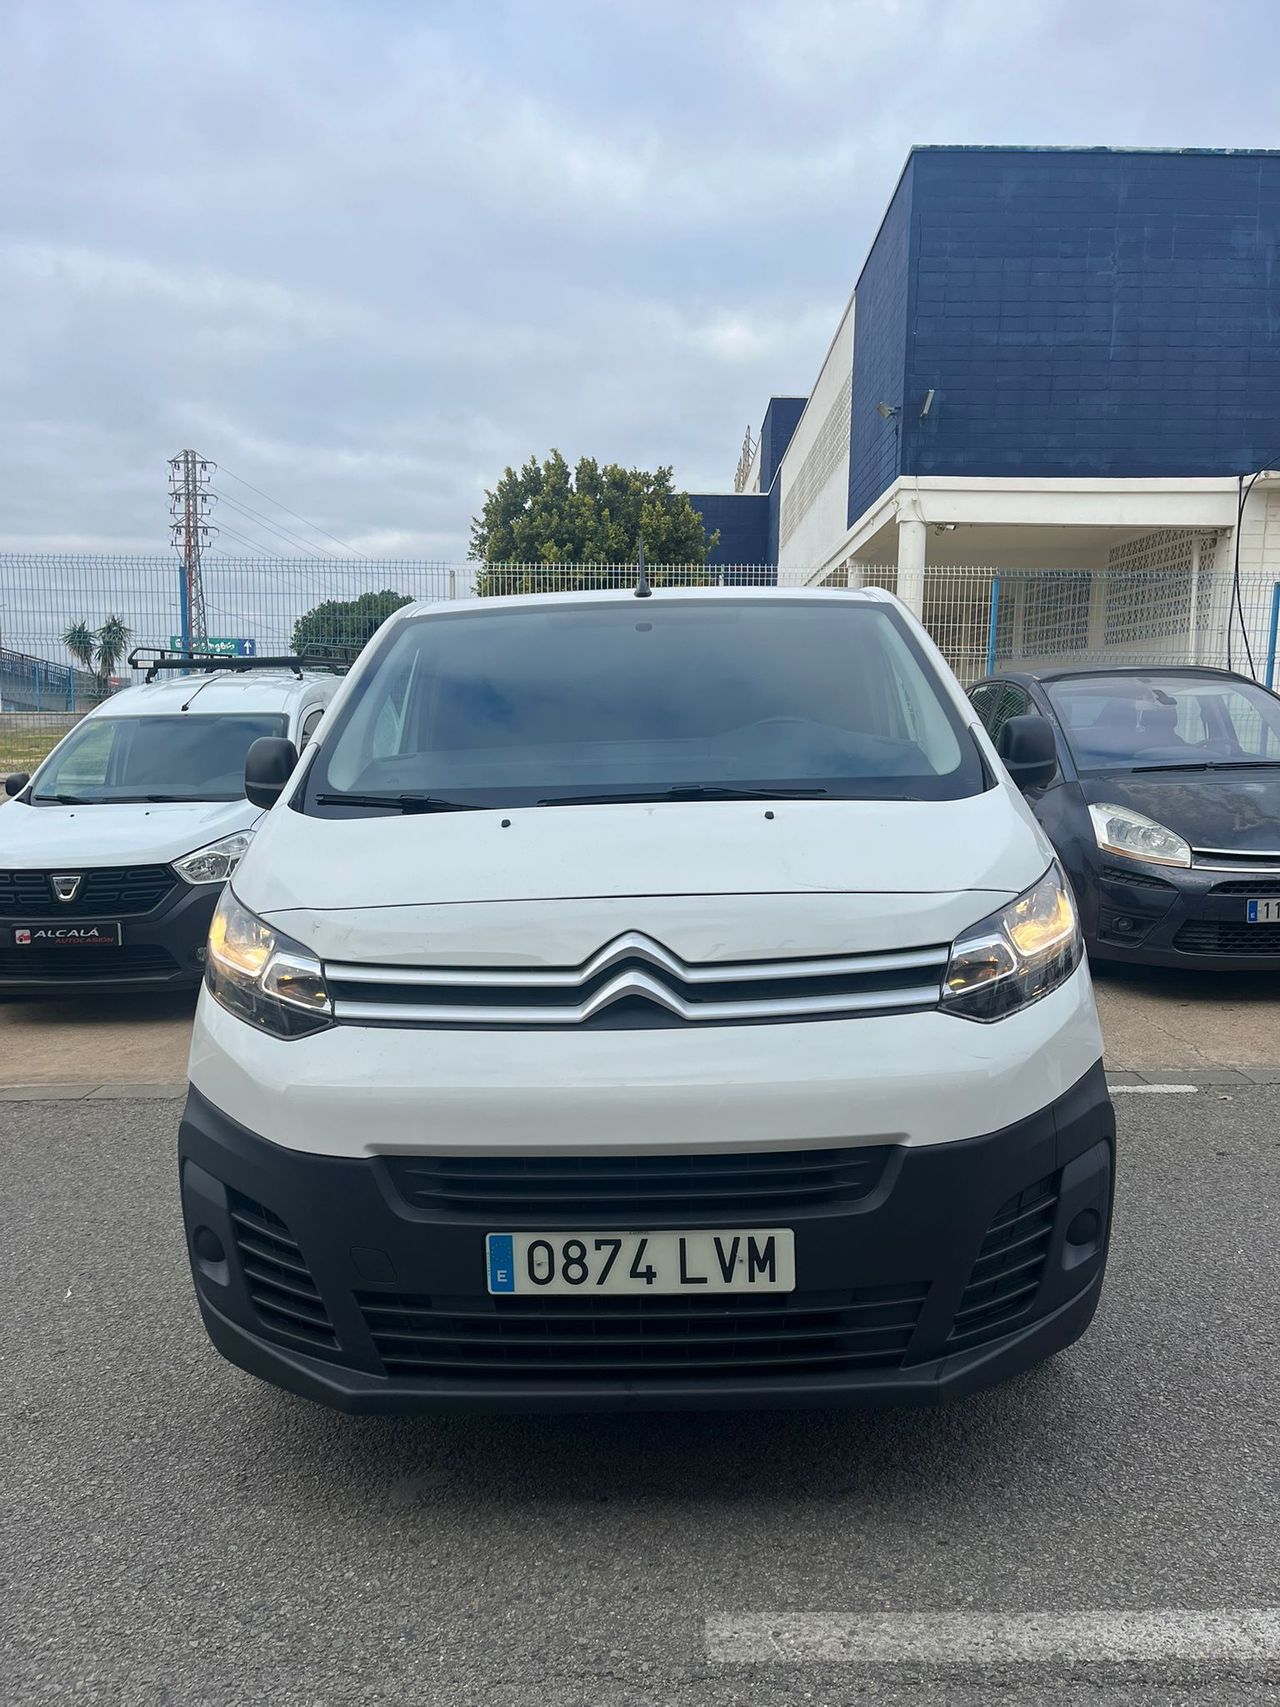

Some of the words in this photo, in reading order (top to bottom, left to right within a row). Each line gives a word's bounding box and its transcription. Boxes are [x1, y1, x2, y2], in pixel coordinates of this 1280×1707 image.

[34, 927, 99, 938] ALCALÁ
[527, 1238, 657, 1285] 0874
[678, 1236, 776, 1284] LVM
[497, 1270, 508, 1282] E
